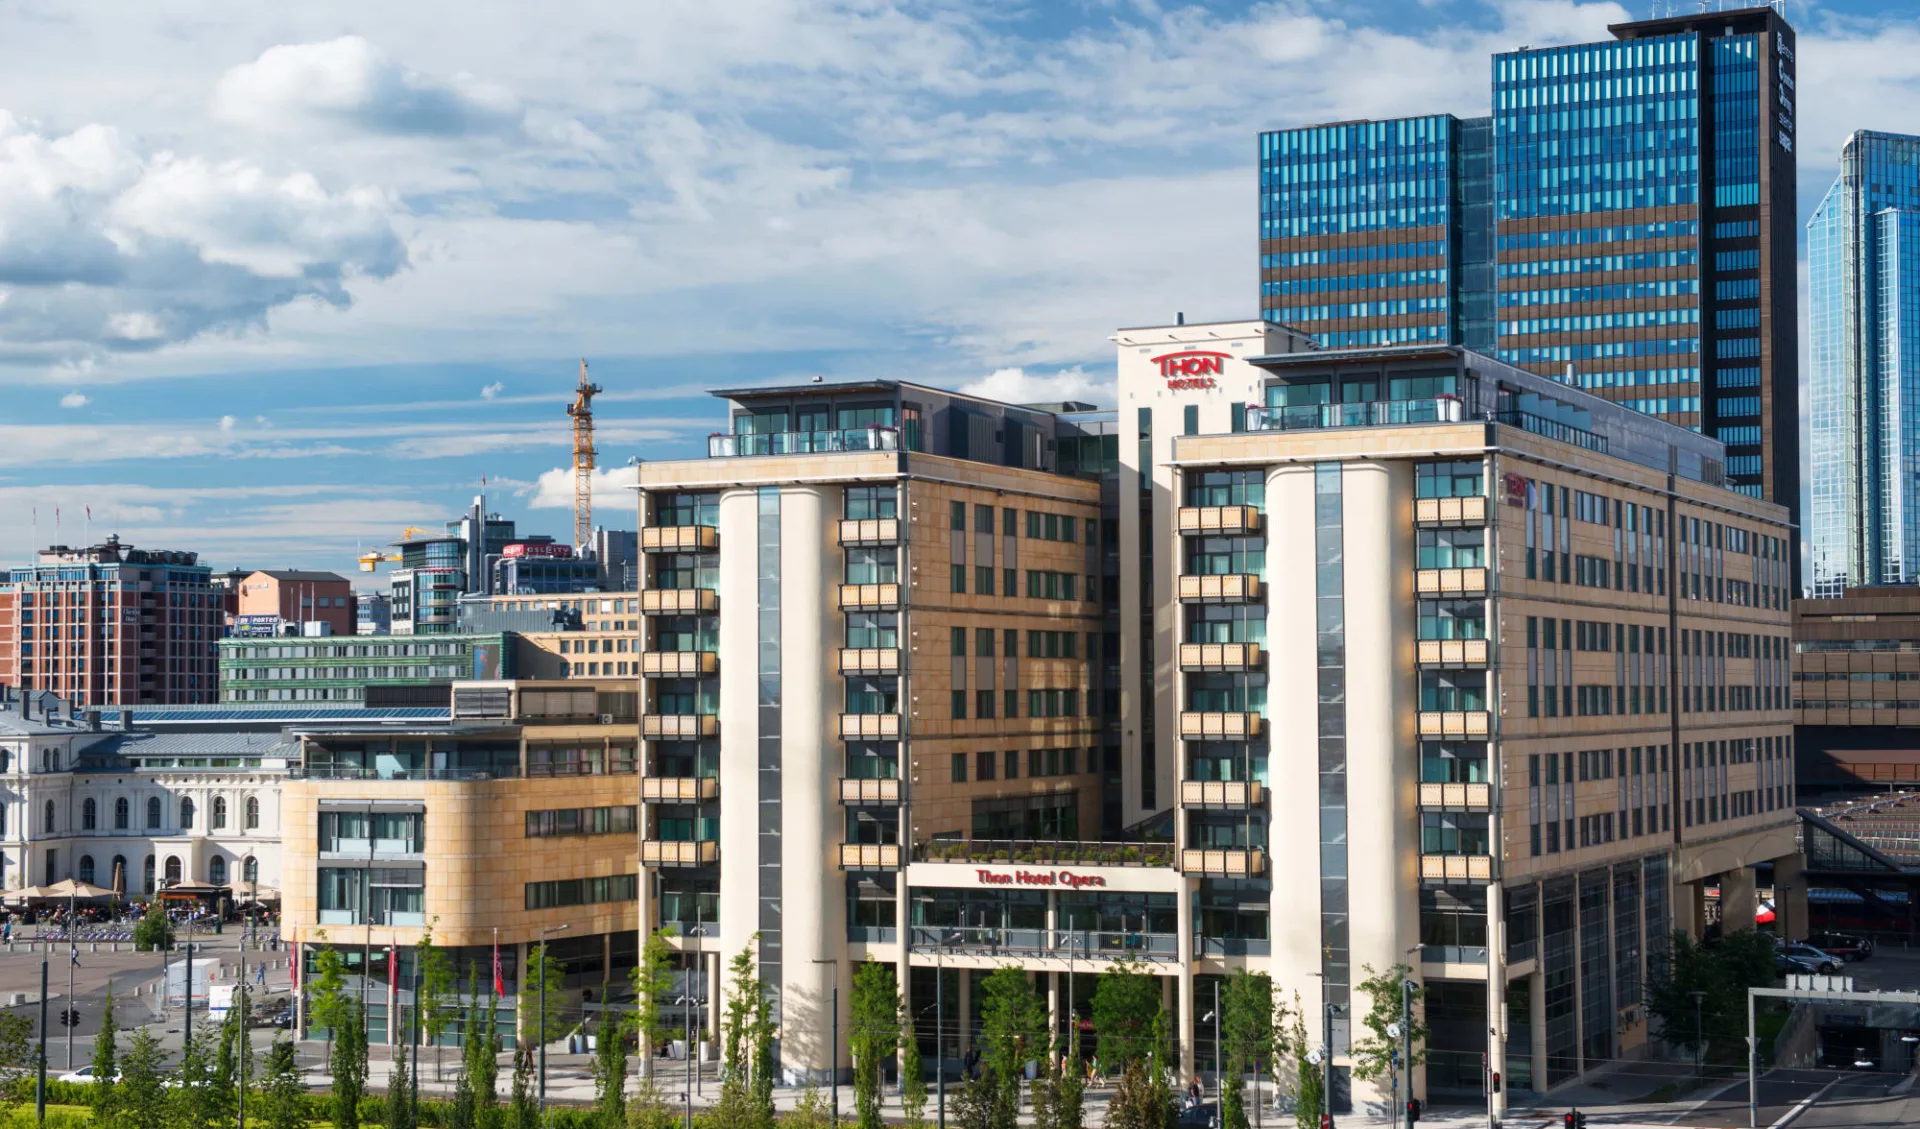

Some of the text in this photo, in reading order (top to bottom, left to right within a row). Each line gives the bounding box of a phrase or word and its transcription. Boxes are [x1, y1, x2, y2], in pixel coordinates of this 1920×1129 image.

[1151, 352, 1229, 376] THON
[1167, 377, 1215, 389] HOTELS
[976, 870, 1106, 889] Thon Hotel Opera
